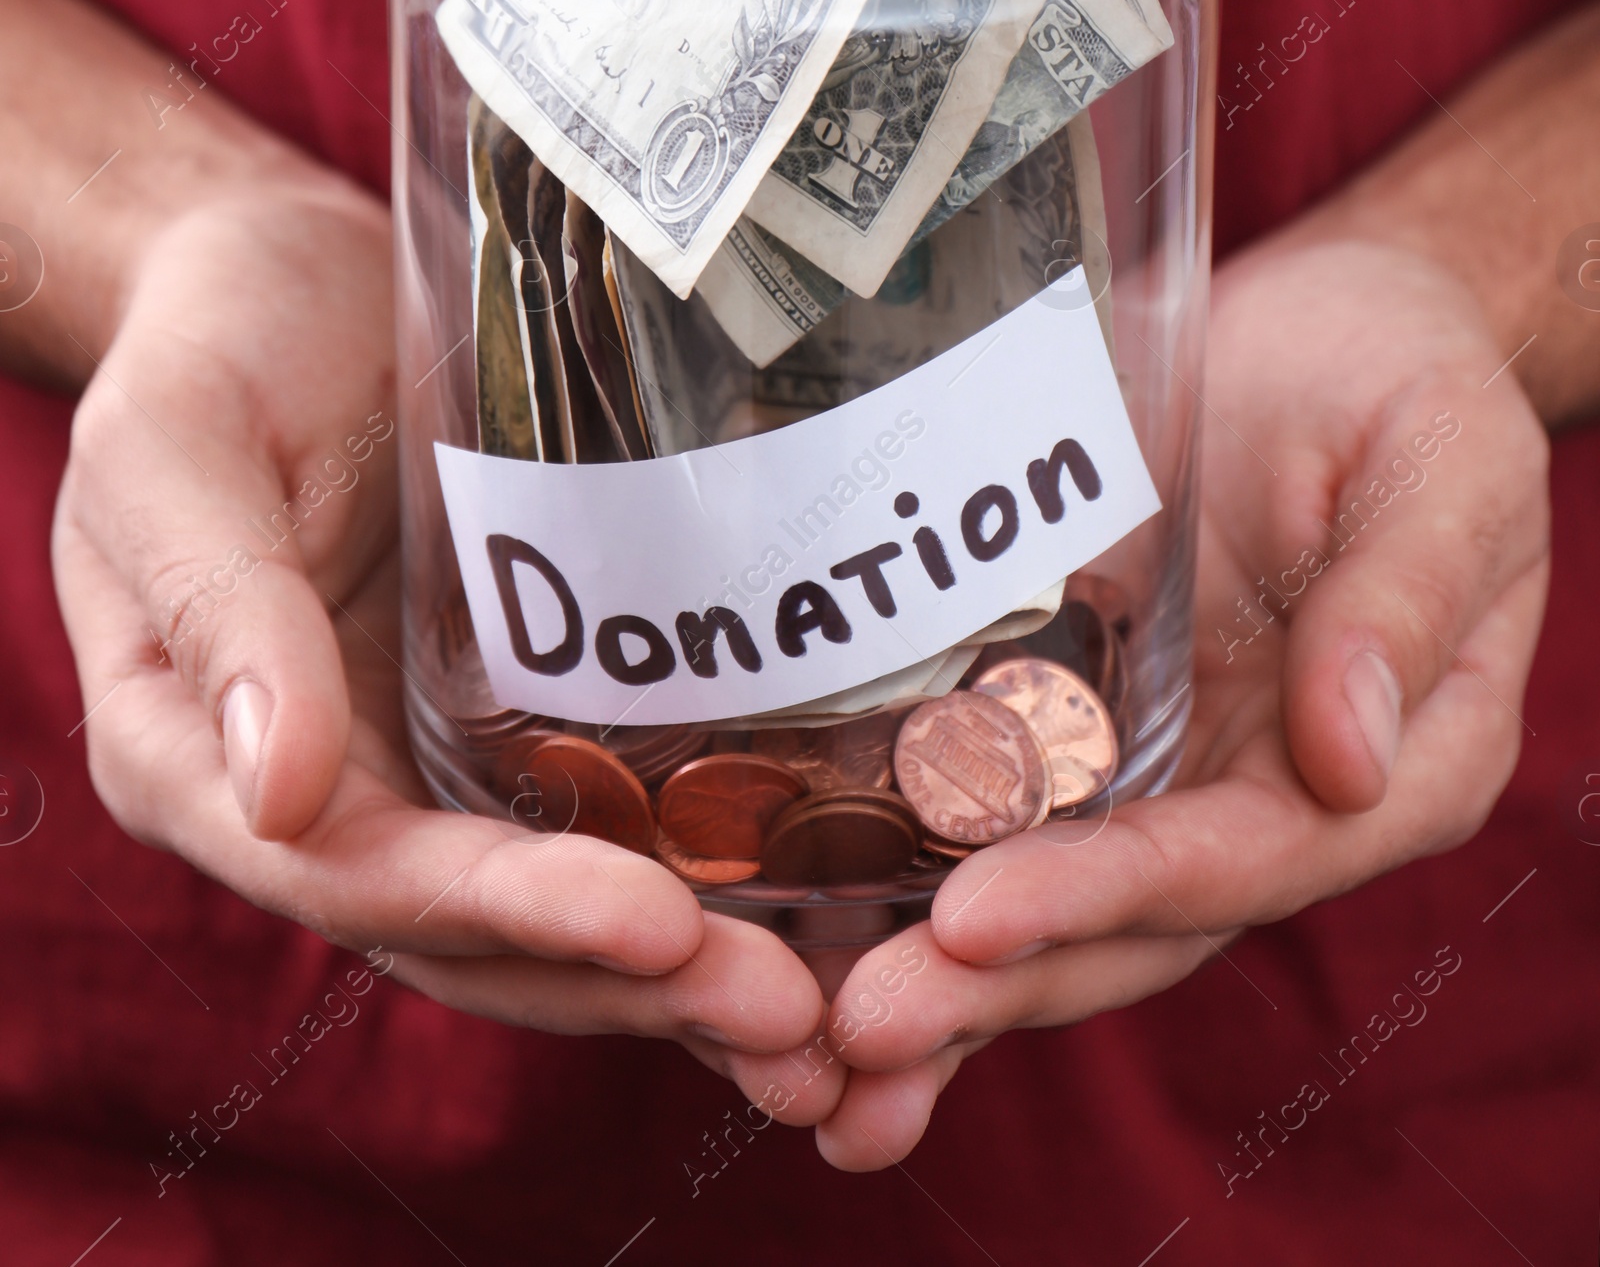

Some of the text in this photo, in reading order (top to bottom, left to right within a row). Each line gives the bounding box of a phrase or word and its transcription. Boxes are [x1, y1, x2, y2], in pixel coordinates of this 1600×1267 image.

[1032, 23, 1095, 104] STA
[814, 117, 895, 184] ONE
[781, 273, 796, 287] IN
[793, 287, 817, 311] GOD
[902, 759, 994, 838] ONE CENT
